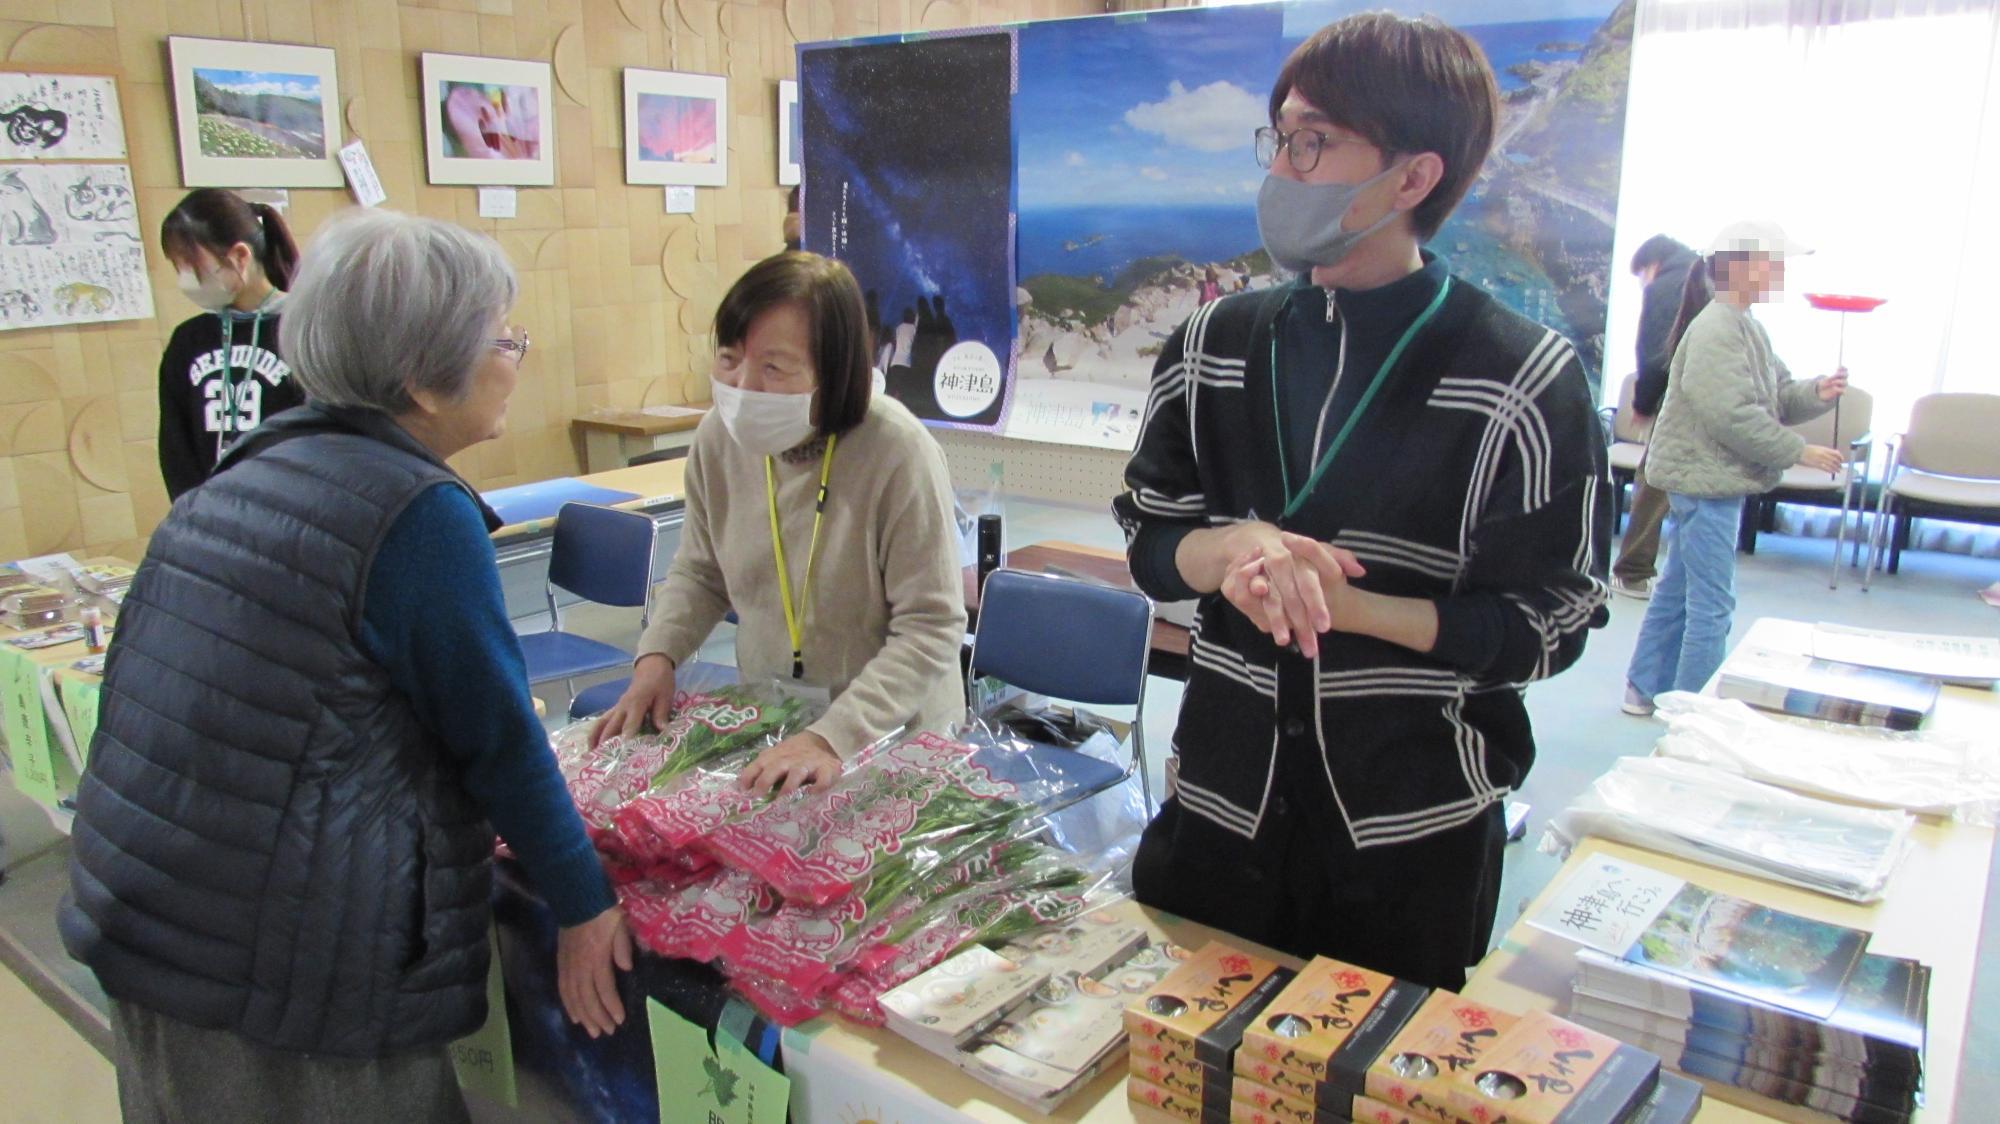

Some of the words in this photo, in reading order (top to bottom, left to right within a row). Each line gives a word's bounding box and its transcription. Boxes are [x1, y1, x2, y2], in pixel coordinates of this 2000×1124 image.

[941, 372, 994, 393] 神津島
[205, 379, 262, 431] 29
